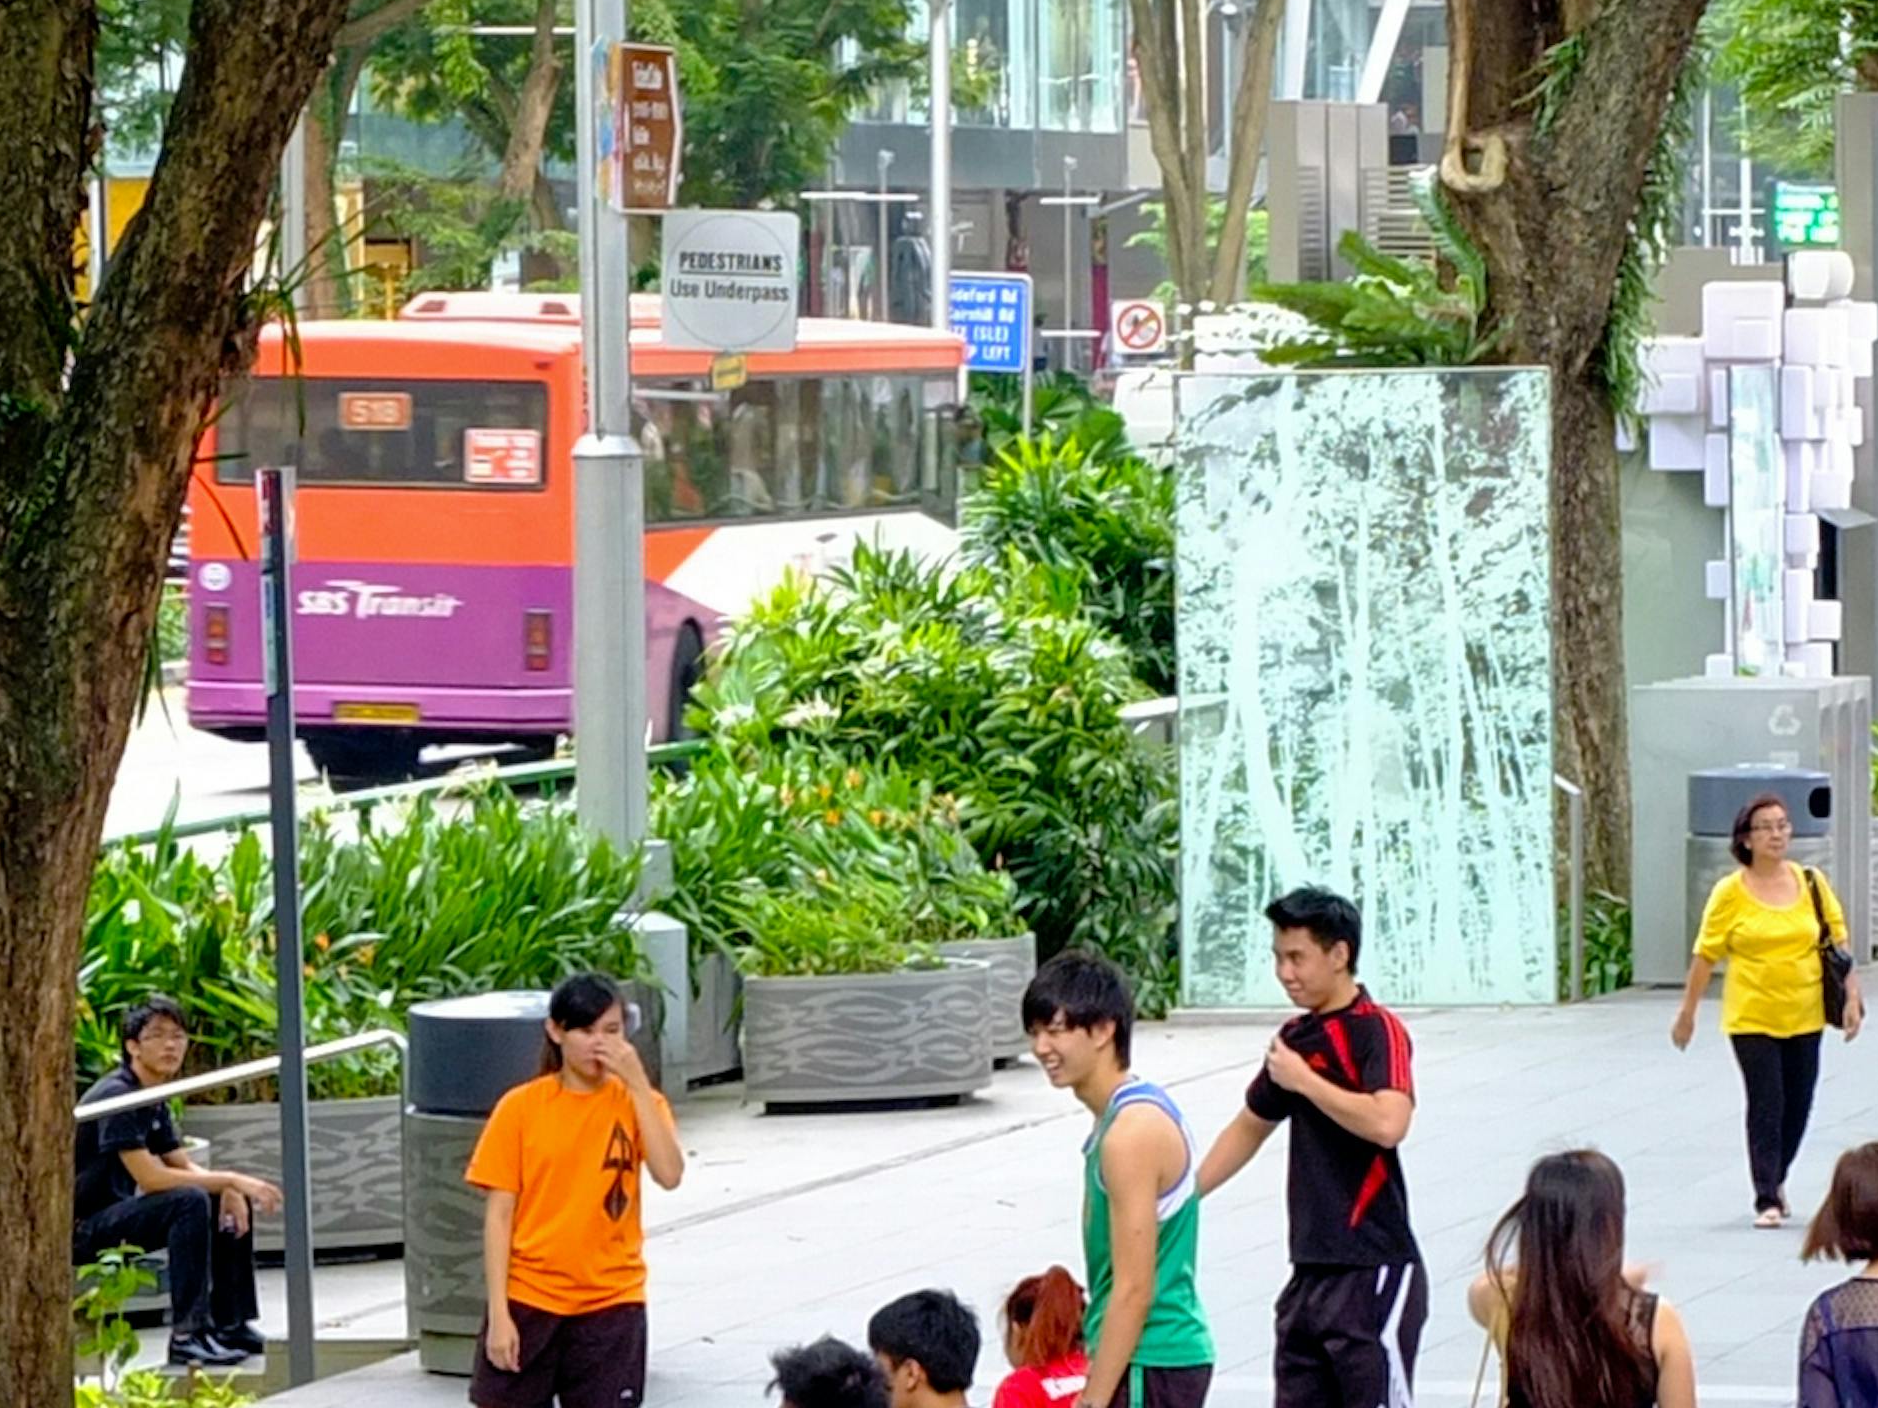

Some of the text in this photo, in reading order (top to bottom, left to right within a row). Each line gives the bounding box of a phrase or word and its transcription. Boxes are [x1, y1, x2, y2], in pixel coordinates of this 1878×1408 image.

[679, 251, 783, 272] PEDESTRIANS
[670, 278, 790, 304] Use Underpass
[982, 344, 1010, 361] LEFT
[295, 584, 466, 620] SBS Transit
